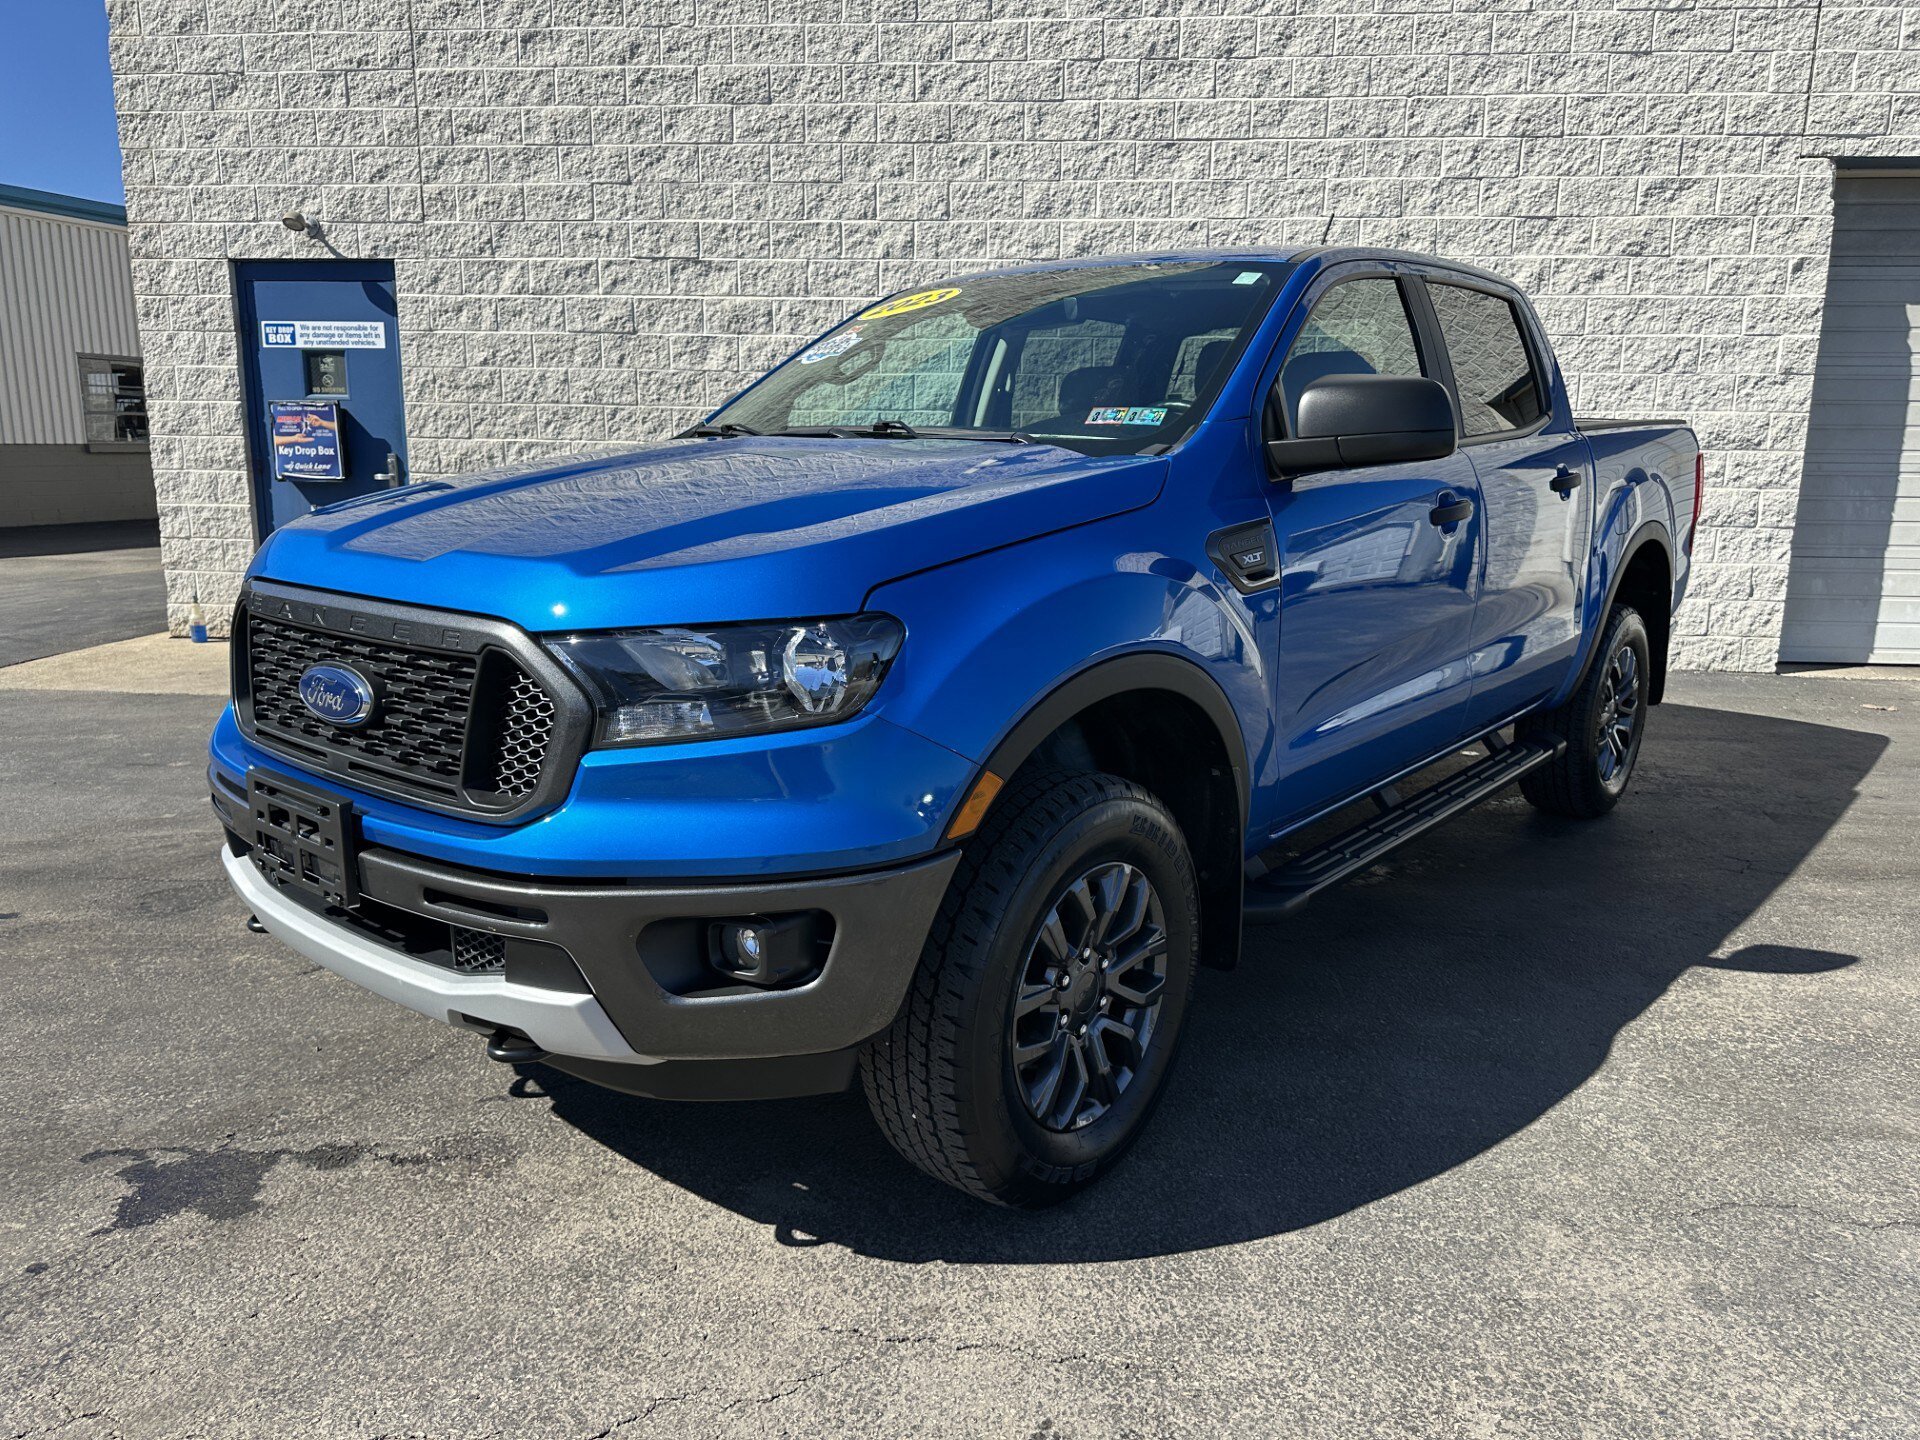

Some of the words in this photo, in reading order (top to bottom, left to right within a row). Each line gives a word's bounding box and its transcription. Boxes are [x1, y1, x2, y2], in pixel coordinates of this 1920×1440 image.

[863, 290, 954, 317] 2023
[334, 324, 368, 332] responsible
[268, 334, 292, 344] BOX
[1092, 412, 1101, 422] 3
[1128, 412, 1138, 422] 3
[278, 445, 293, 458] Key
[294, 445, 317, 458] Drop
[318, 445, 335, 456] Box
[294, 462, 314, 471] Quick
[314, 462, 332, 470] Lane
[1242, 552, 1263, 565] XLT
[250, 591, 463, 650] RANGER
[306, 673, 345, 712] Ford
